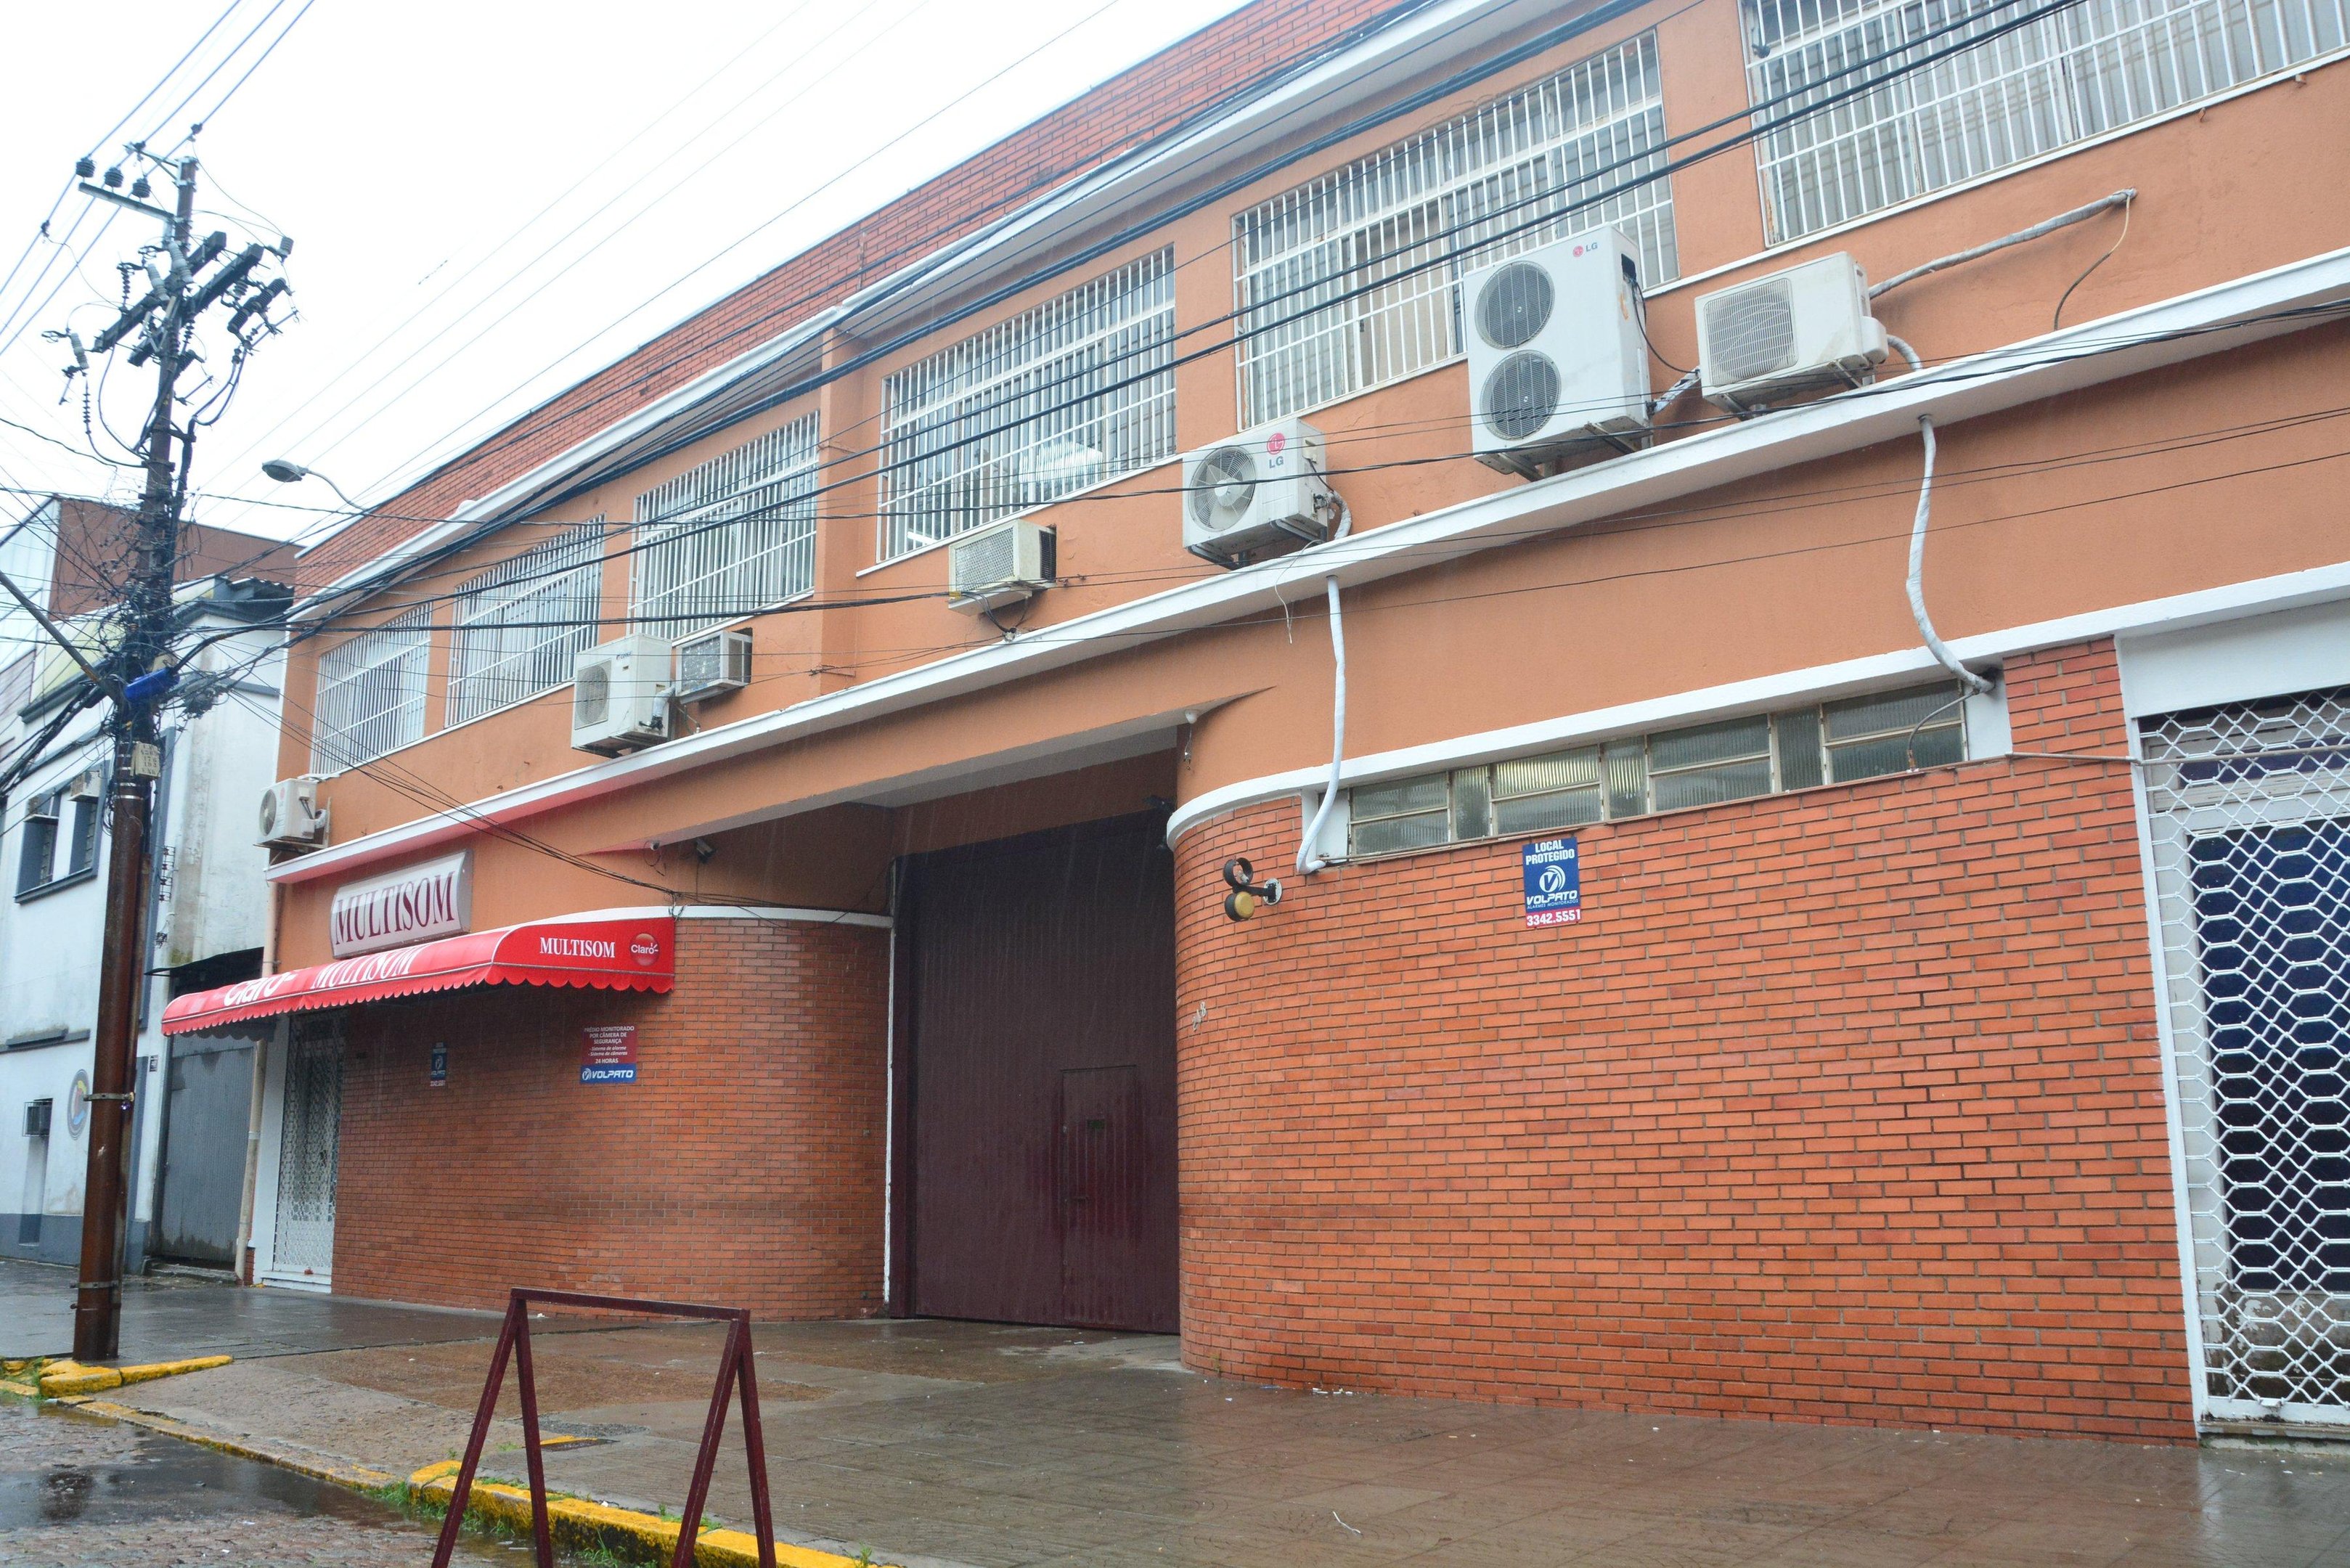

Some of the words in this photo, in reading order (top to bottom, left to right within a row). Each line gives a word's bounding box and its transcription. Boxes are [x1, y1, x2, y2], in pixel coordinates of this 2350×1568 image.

[1586, 242, 1598, 252] LG
[1269, 456, 1284, 468] LG
[1535, 839, 1564, 853] LOCAL
[1525, 849, 1575, 865] PROTEGIDO
[1526, 890, 1578, 905] VOLPATO
[336, 870, 455, 945] MULTISOM
[1526, 909, 1581, 926] 3342.5551
[539, 936, 616, 958] MULTISOM
[630, 943, 656, 955] Claro
[224, 971, 295, 1006] Claro
[310, 943, 433, 989] MULTISOM
[592, 1069, 634, 1079] VOLPATO
